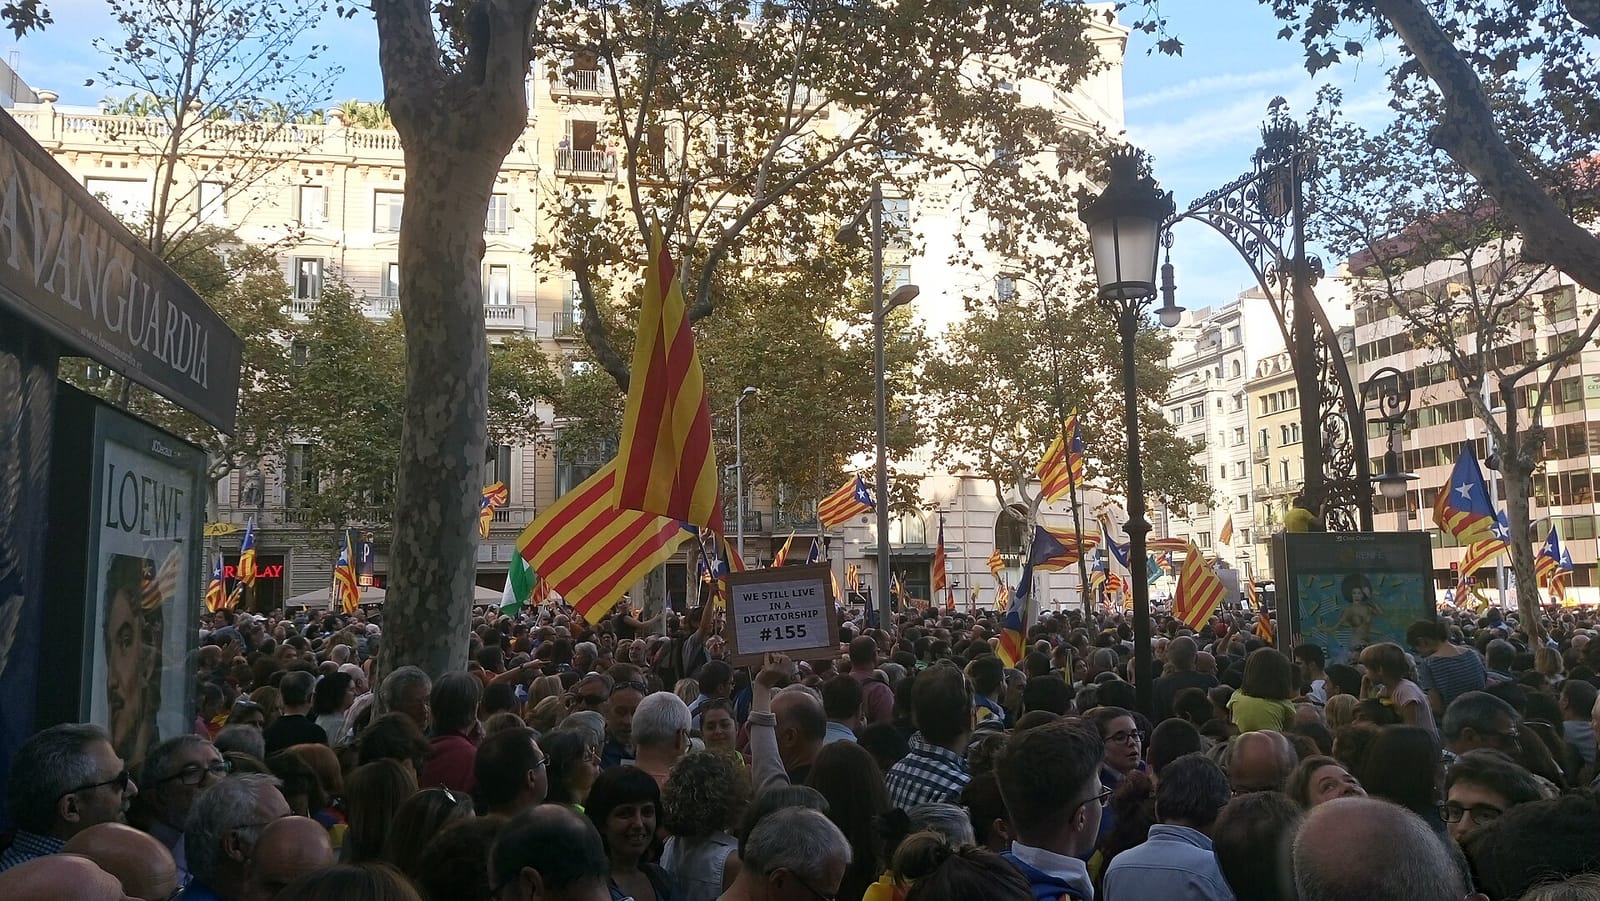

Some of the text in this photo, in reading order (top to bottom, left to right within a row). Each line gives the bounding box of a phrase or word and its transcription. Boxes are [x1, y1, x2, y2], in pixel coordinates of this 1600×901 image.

[30, 191, 209, 390] VANGUARDIA
[105, 463, 184, 543] LOEWE
[224, 565, 283, 578] RLAY
[742, 587, 816, 602] WE STILL LIVE
[769, 601, 792, 610] IN A
[743, 609, 819, 624] DICTATORSHIP
[760, 624, 808, 642] #155
